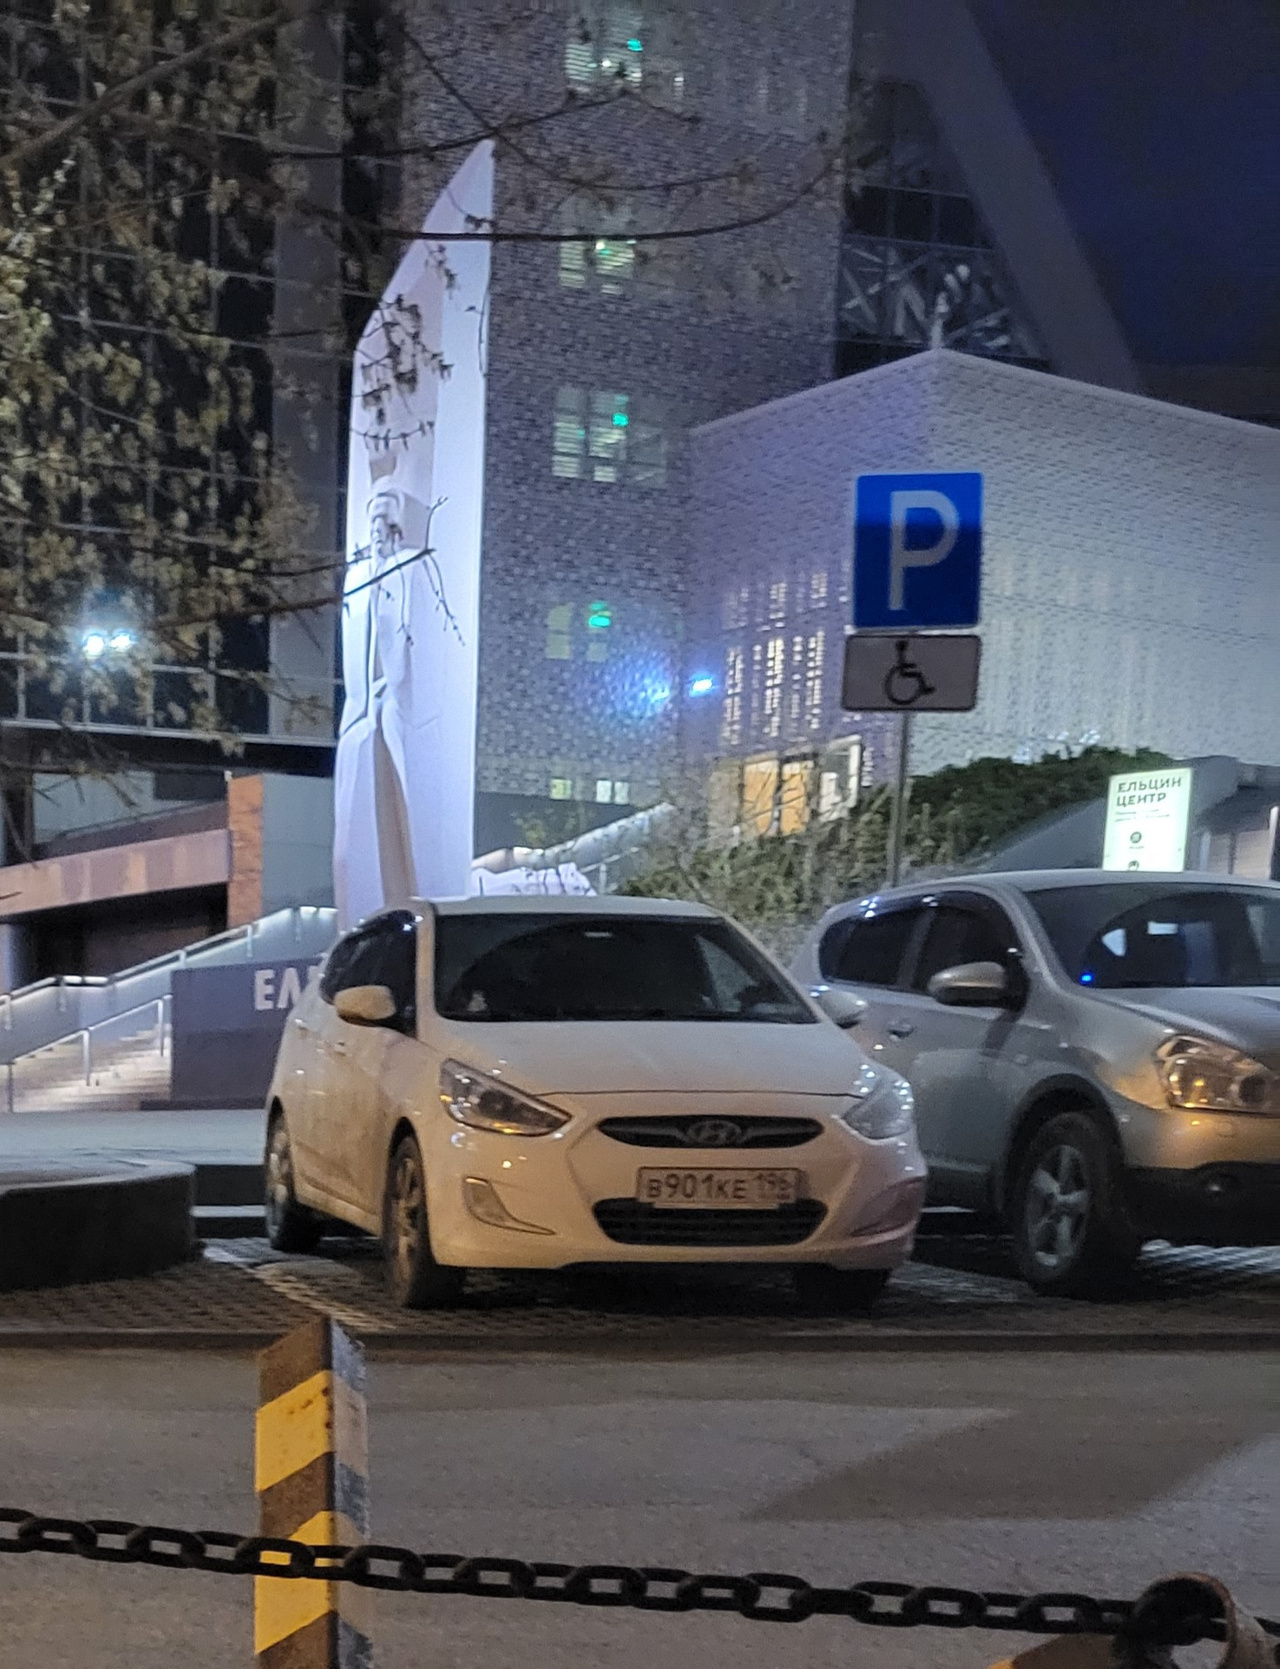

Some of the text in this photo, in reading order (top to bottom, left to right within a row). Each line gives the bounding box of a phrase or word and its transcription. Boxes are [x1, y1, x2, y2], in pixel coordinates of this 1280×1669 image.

[889, 489, 961, 611] P
[1117, 777, 1182, 793] ЕЛЬЦИН
[1116, 793, 1167, 808] ЦЕНТР
